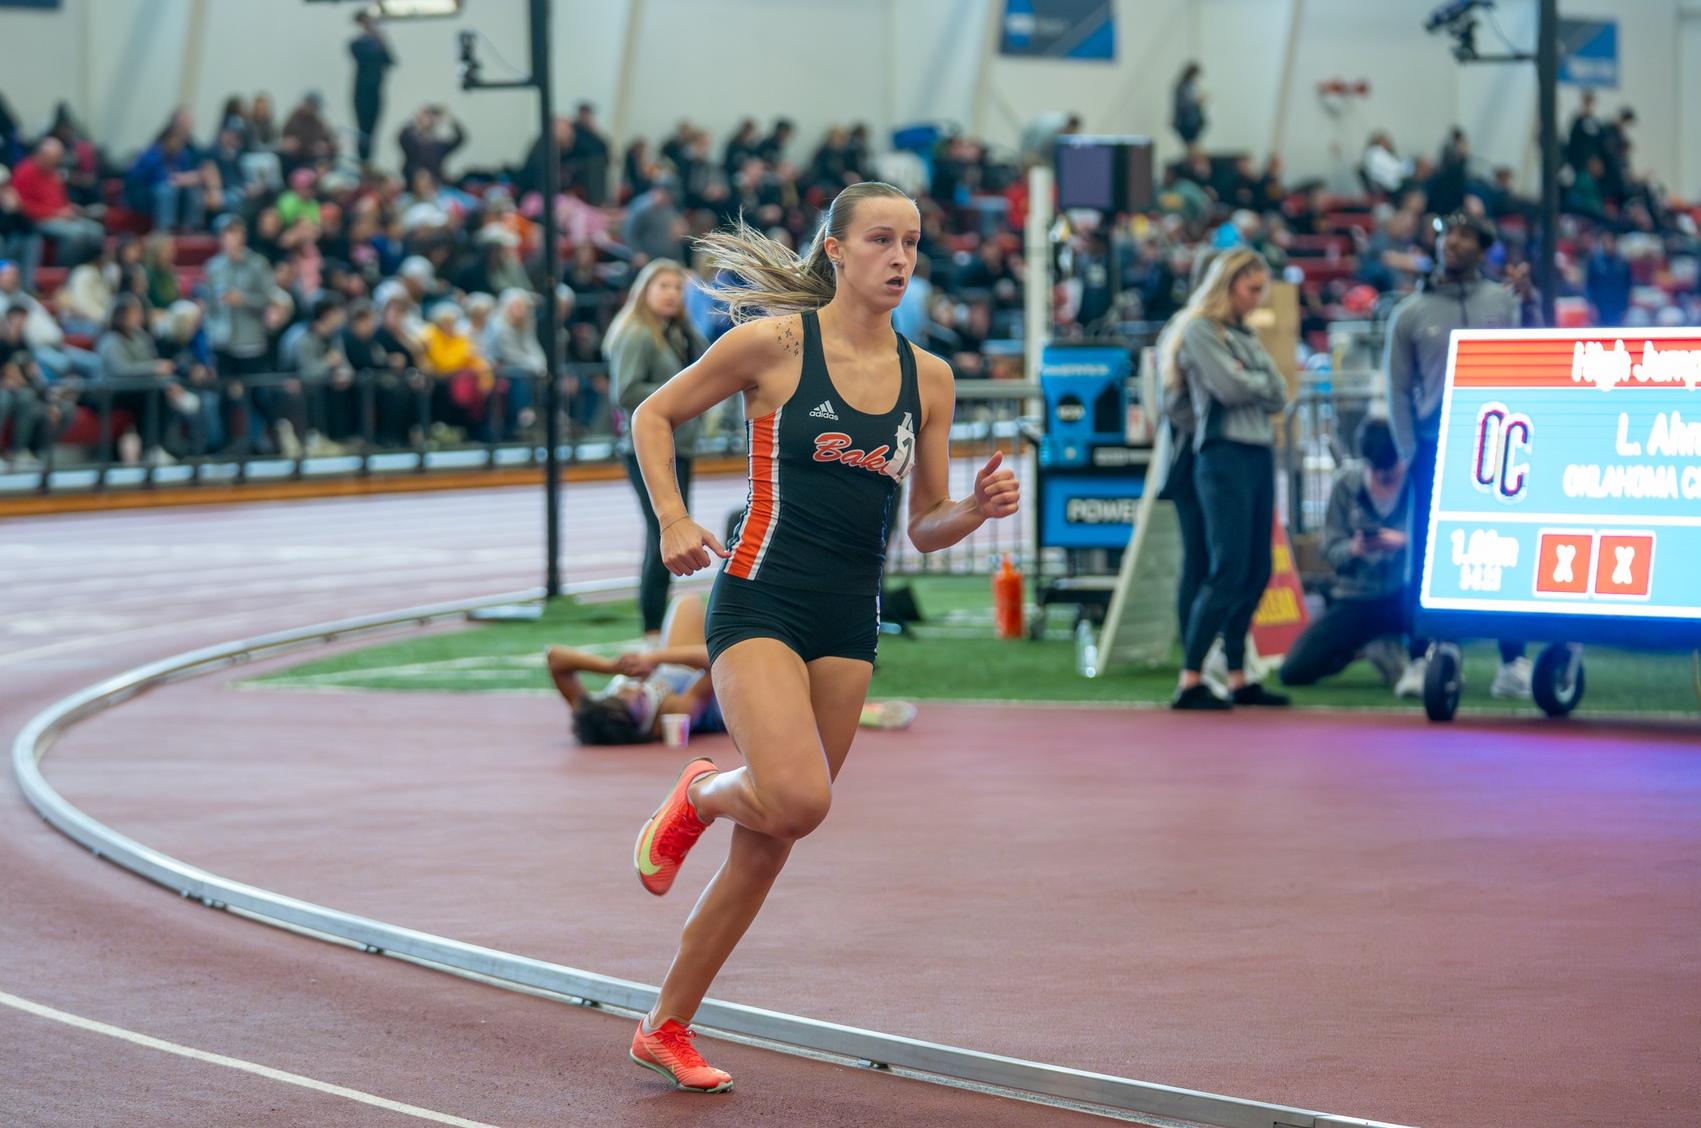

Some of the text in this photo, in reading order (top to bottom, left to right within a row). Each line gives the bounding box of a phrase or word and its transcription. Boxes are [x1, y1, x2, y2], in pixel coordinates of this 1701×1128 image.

[1571, 339, 1632, 391] High
[809, 411, 839, 421] adidas
[1615, 411, 1642, 457] L.
[1562, 463, 1679, 500] OKLAHOMA
[1067, 498, 1138, 524] POWE
[1553, 544, 1635, 584] X X
